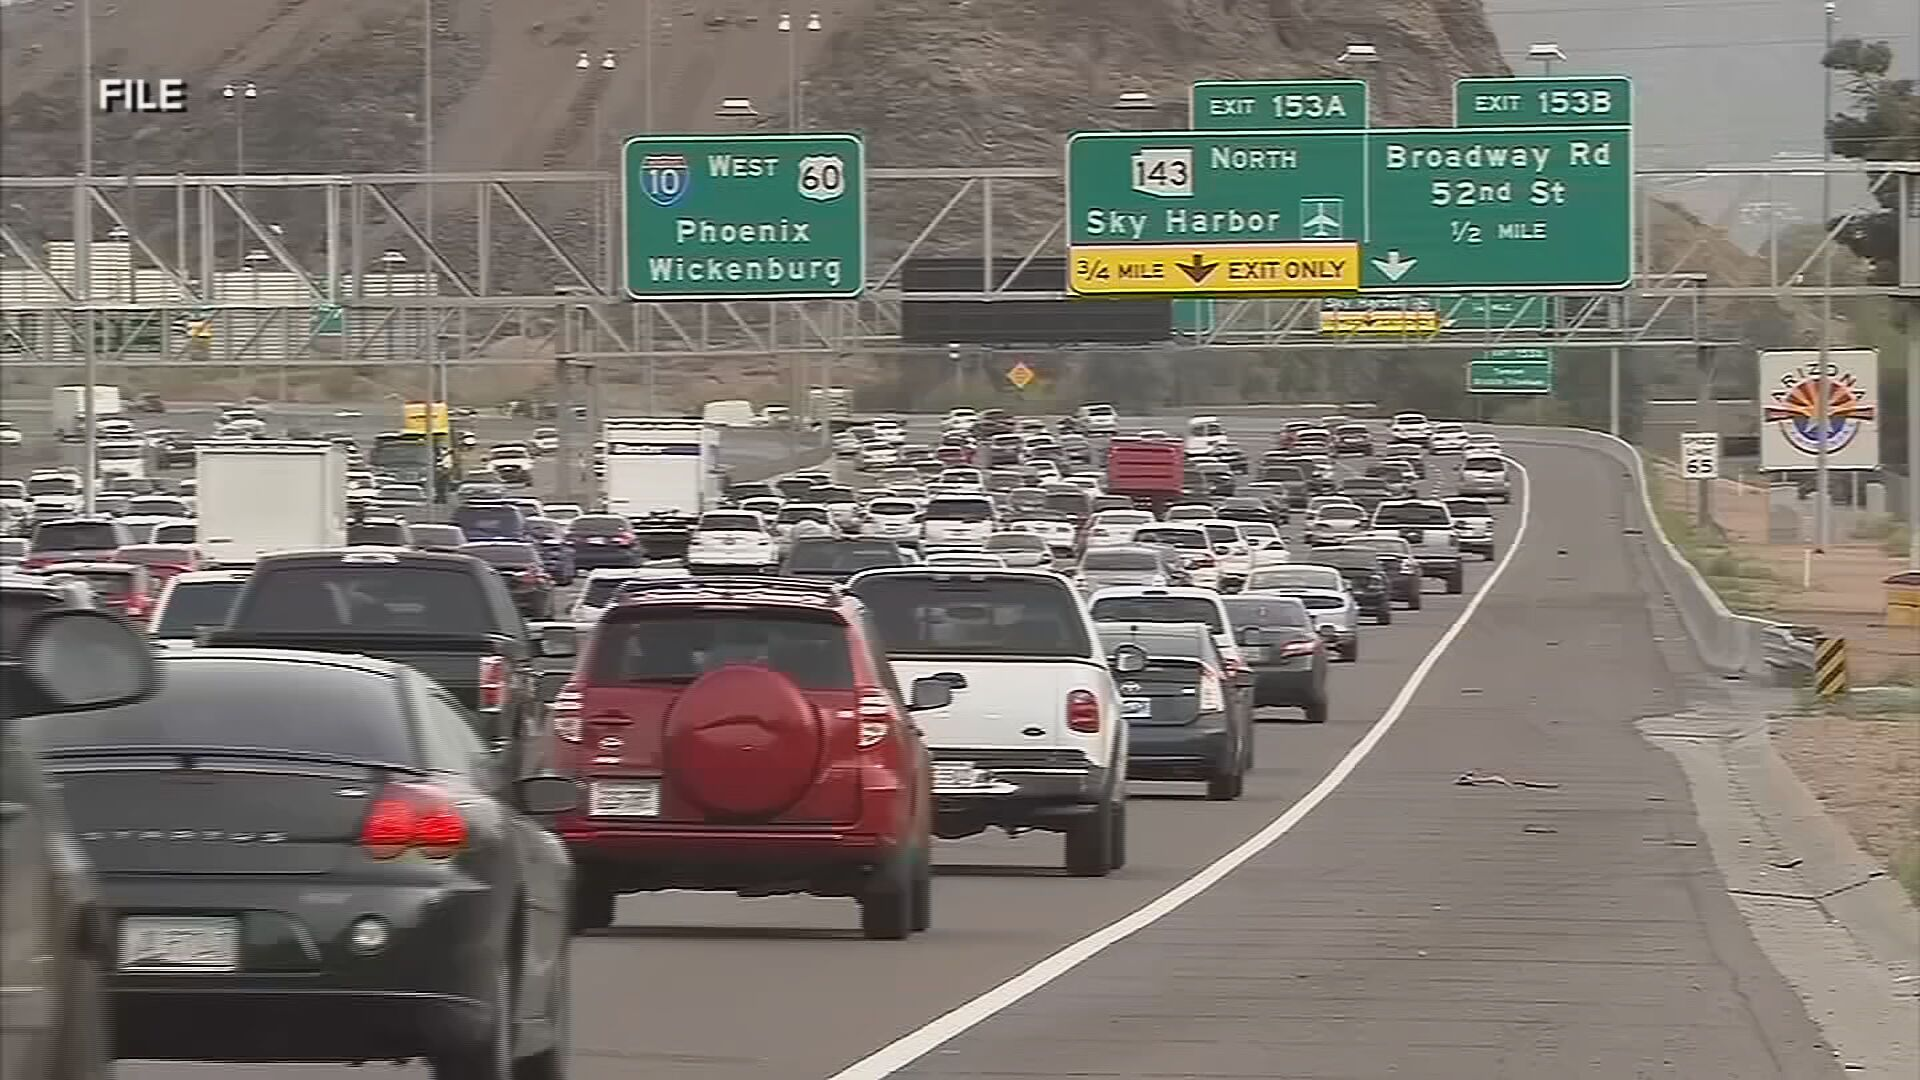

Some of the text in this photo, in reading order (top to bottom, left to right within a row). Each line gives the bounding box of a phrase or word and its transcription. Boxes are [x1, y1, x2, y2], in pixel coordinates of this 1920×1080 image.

[1210, 95, 1347, 118] EXIT 153A
[1474, 90, 1612, 114] EXIT 153B
[1137, 146, 1299, 186] 143 NORTH
[1385, 141, 1611, 172] Broadway Rd
[651, 154, 840, 195] 10 WEST 60
[1430, 180, 1566, 205] 52nd St
[675, 217, 811, 243] Phoenix
[1086, 208, 1281, 239] Sky Harbor
[1498, 223, 1548, 240] MILE
[650, 257, 842, 287] Wickenburg
[1118, 263, 1166, 279] MILE
[1228, 260, 1346, 280] EXIT ONLY
[1770, 361, 1867, 401] ARIZONA
[1687, 459, 1713, 474] 65
